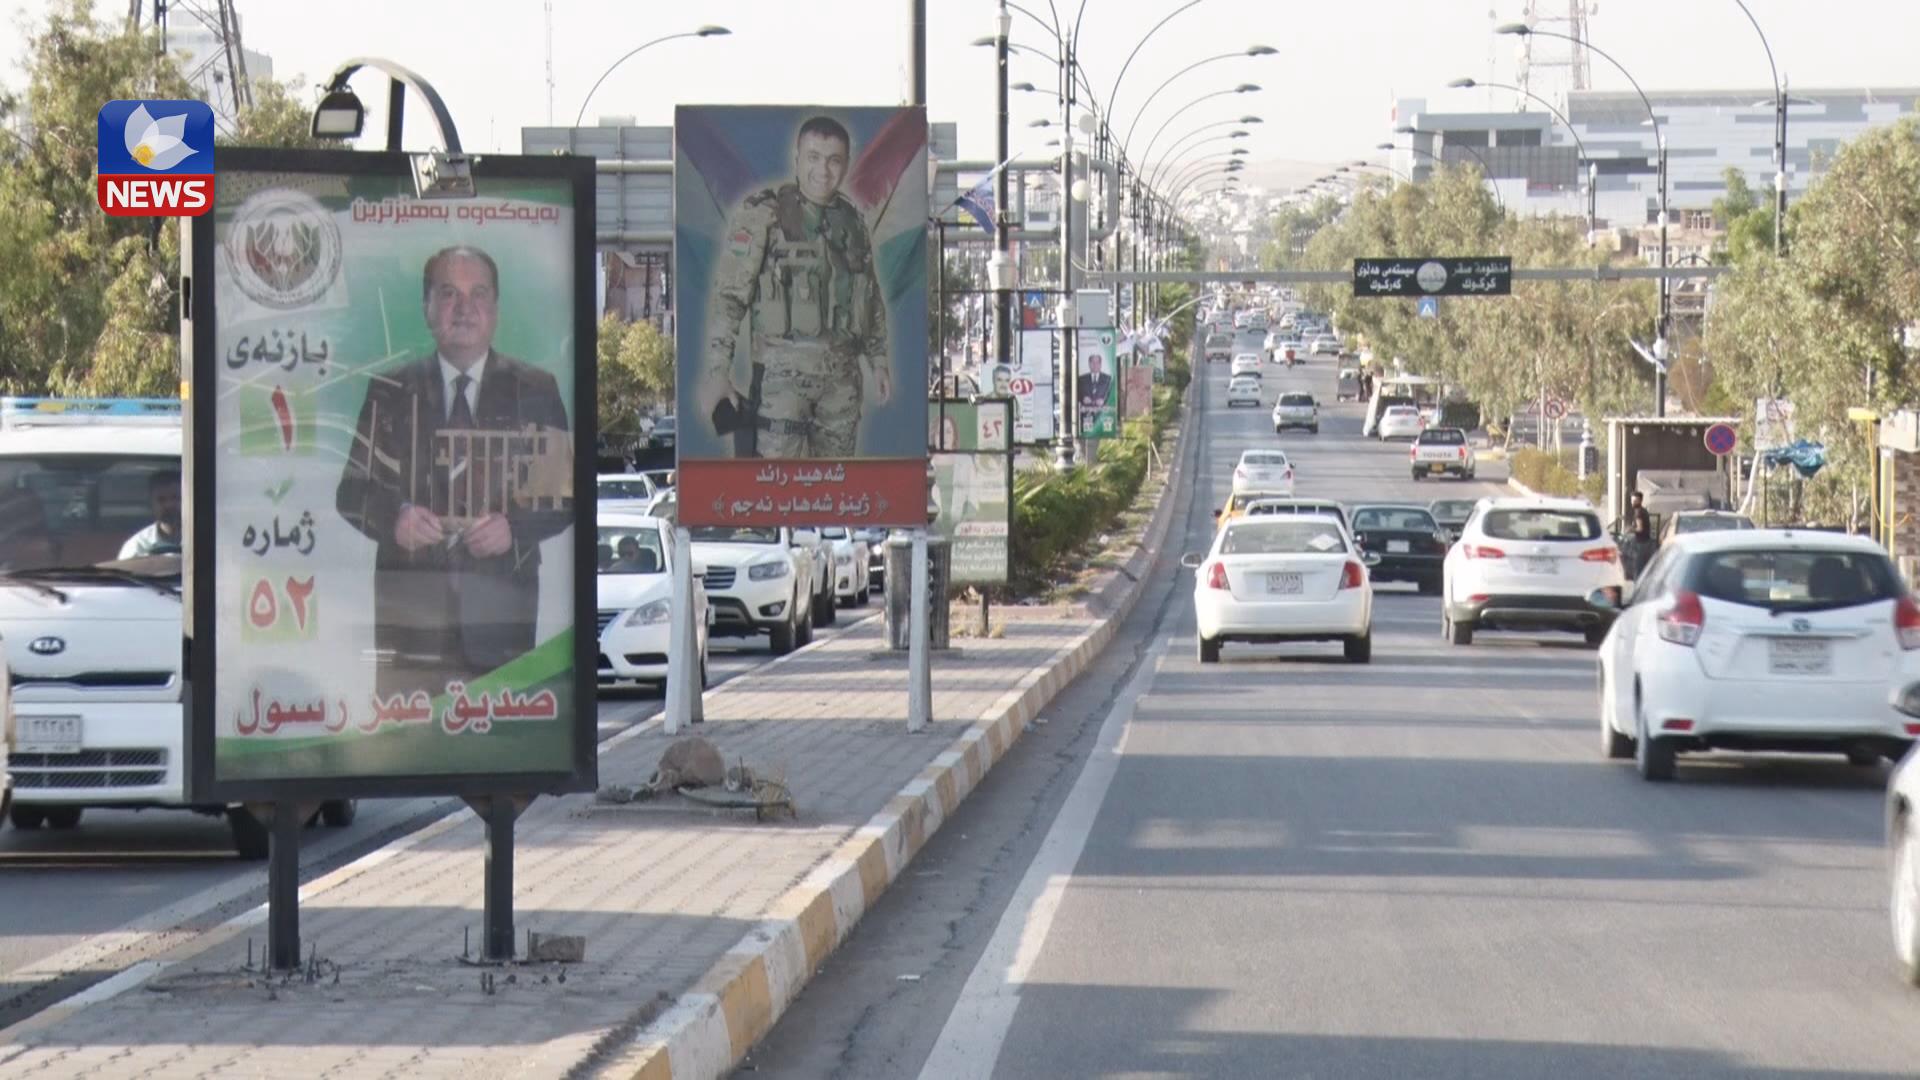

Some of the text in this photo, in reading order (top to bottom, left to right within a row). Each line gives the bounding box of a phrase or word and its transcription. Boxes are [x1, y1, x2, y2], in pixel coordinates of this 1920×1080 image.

[250, 575, 315, 631] ٥٢
[237, 687, 348, 734] رسول
[359, 690, 432, 732] عمر
